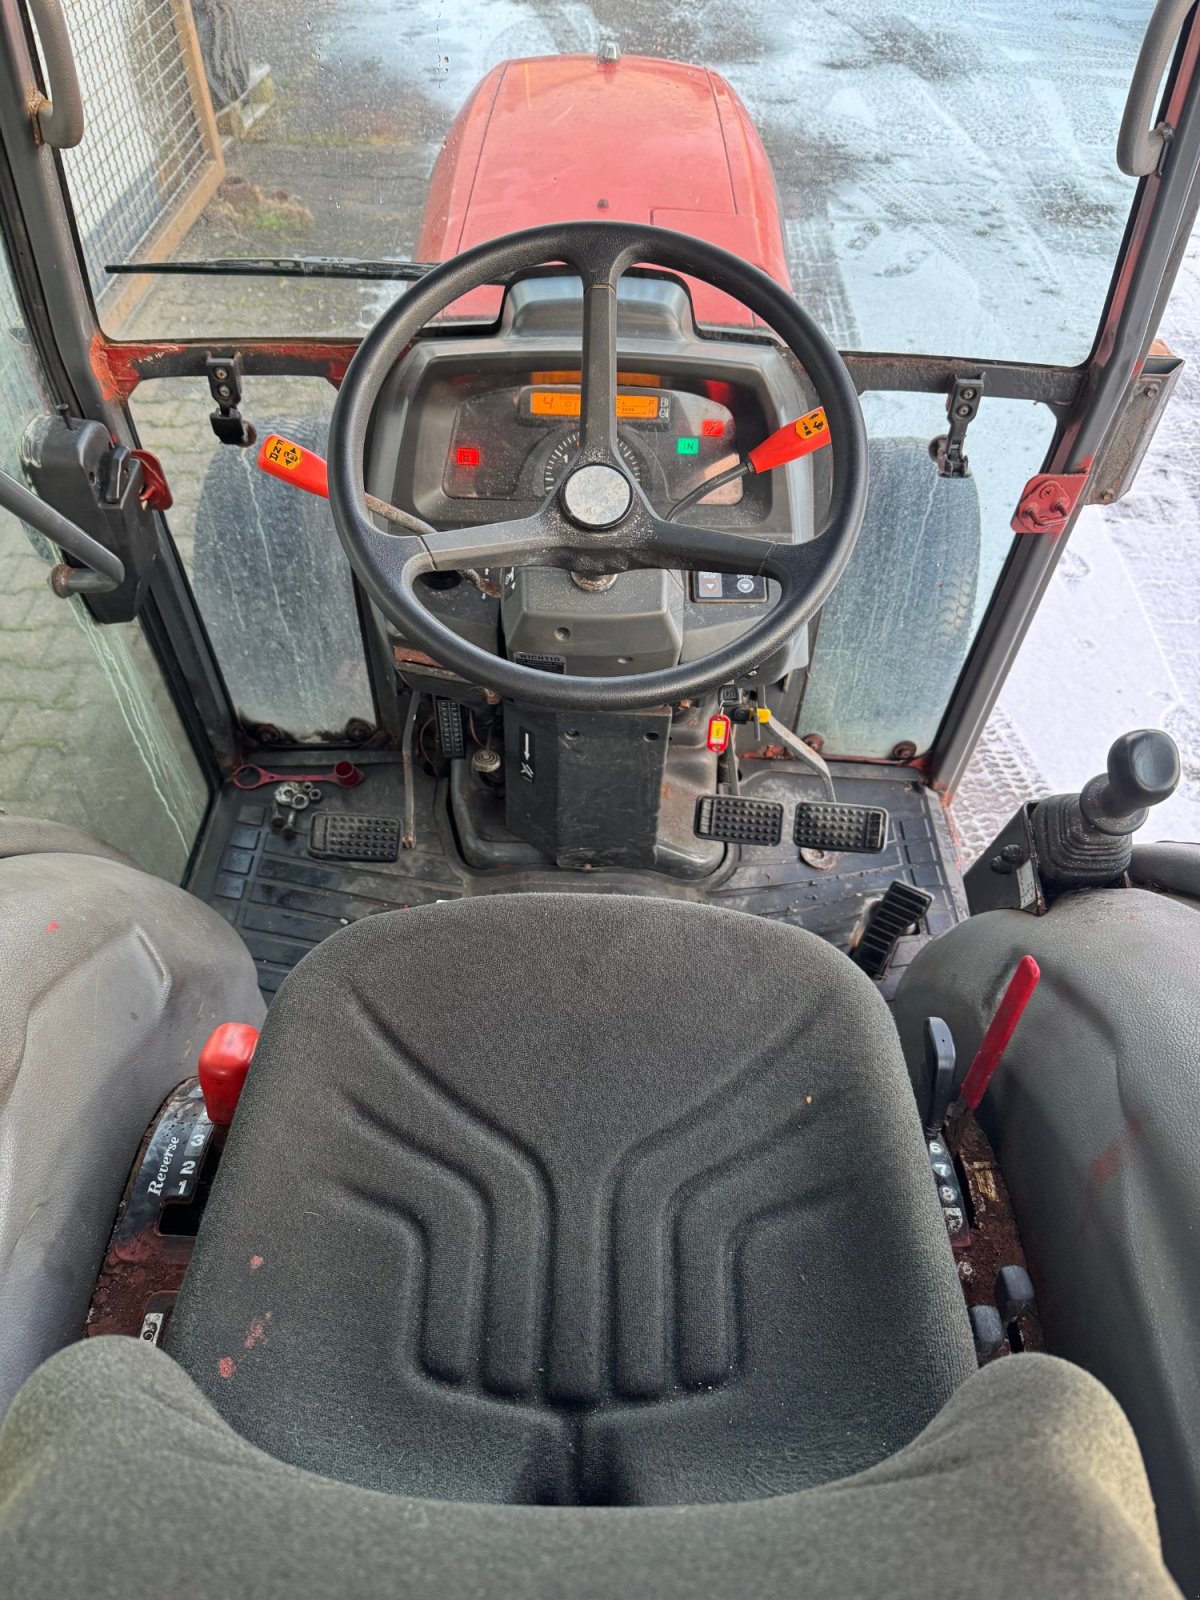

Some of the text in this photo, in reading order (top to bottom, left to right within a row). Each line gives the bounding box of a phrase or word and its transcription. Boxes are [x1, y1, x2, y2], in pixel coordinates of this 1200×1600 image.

[190, 1134, 205, 1147] 3
[929, 1142, 942, 1153] 6
[147, 1136, 180, 1197] Reverse
[180, 1160, 196, 1175] 2
[934, 1163, 947, 1177] 7
[178, 1180, 188, 1195] 1
[941, 1186, 955, 1201] 8
